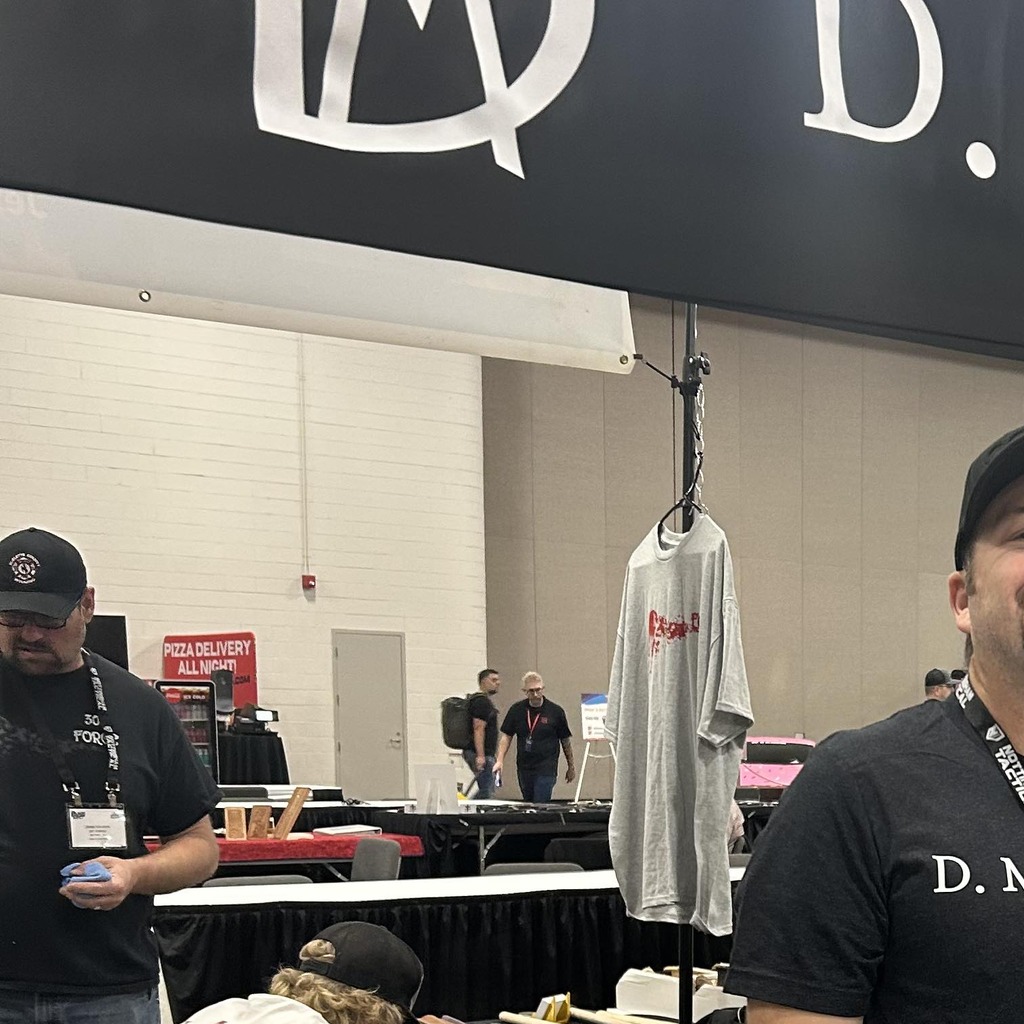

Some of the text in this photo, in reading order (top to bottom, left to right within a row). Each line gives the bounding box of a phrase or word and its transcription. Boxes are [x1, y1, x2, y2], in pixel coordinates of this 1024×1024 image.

[803, 0, 997, 180] D.
[164, 640, 251, 658] PIZZA DELIVERY
[178, 660, 199, 675] ALL
[84, 713, 100, 726] 30
[931, 854, 986, 895] D.
